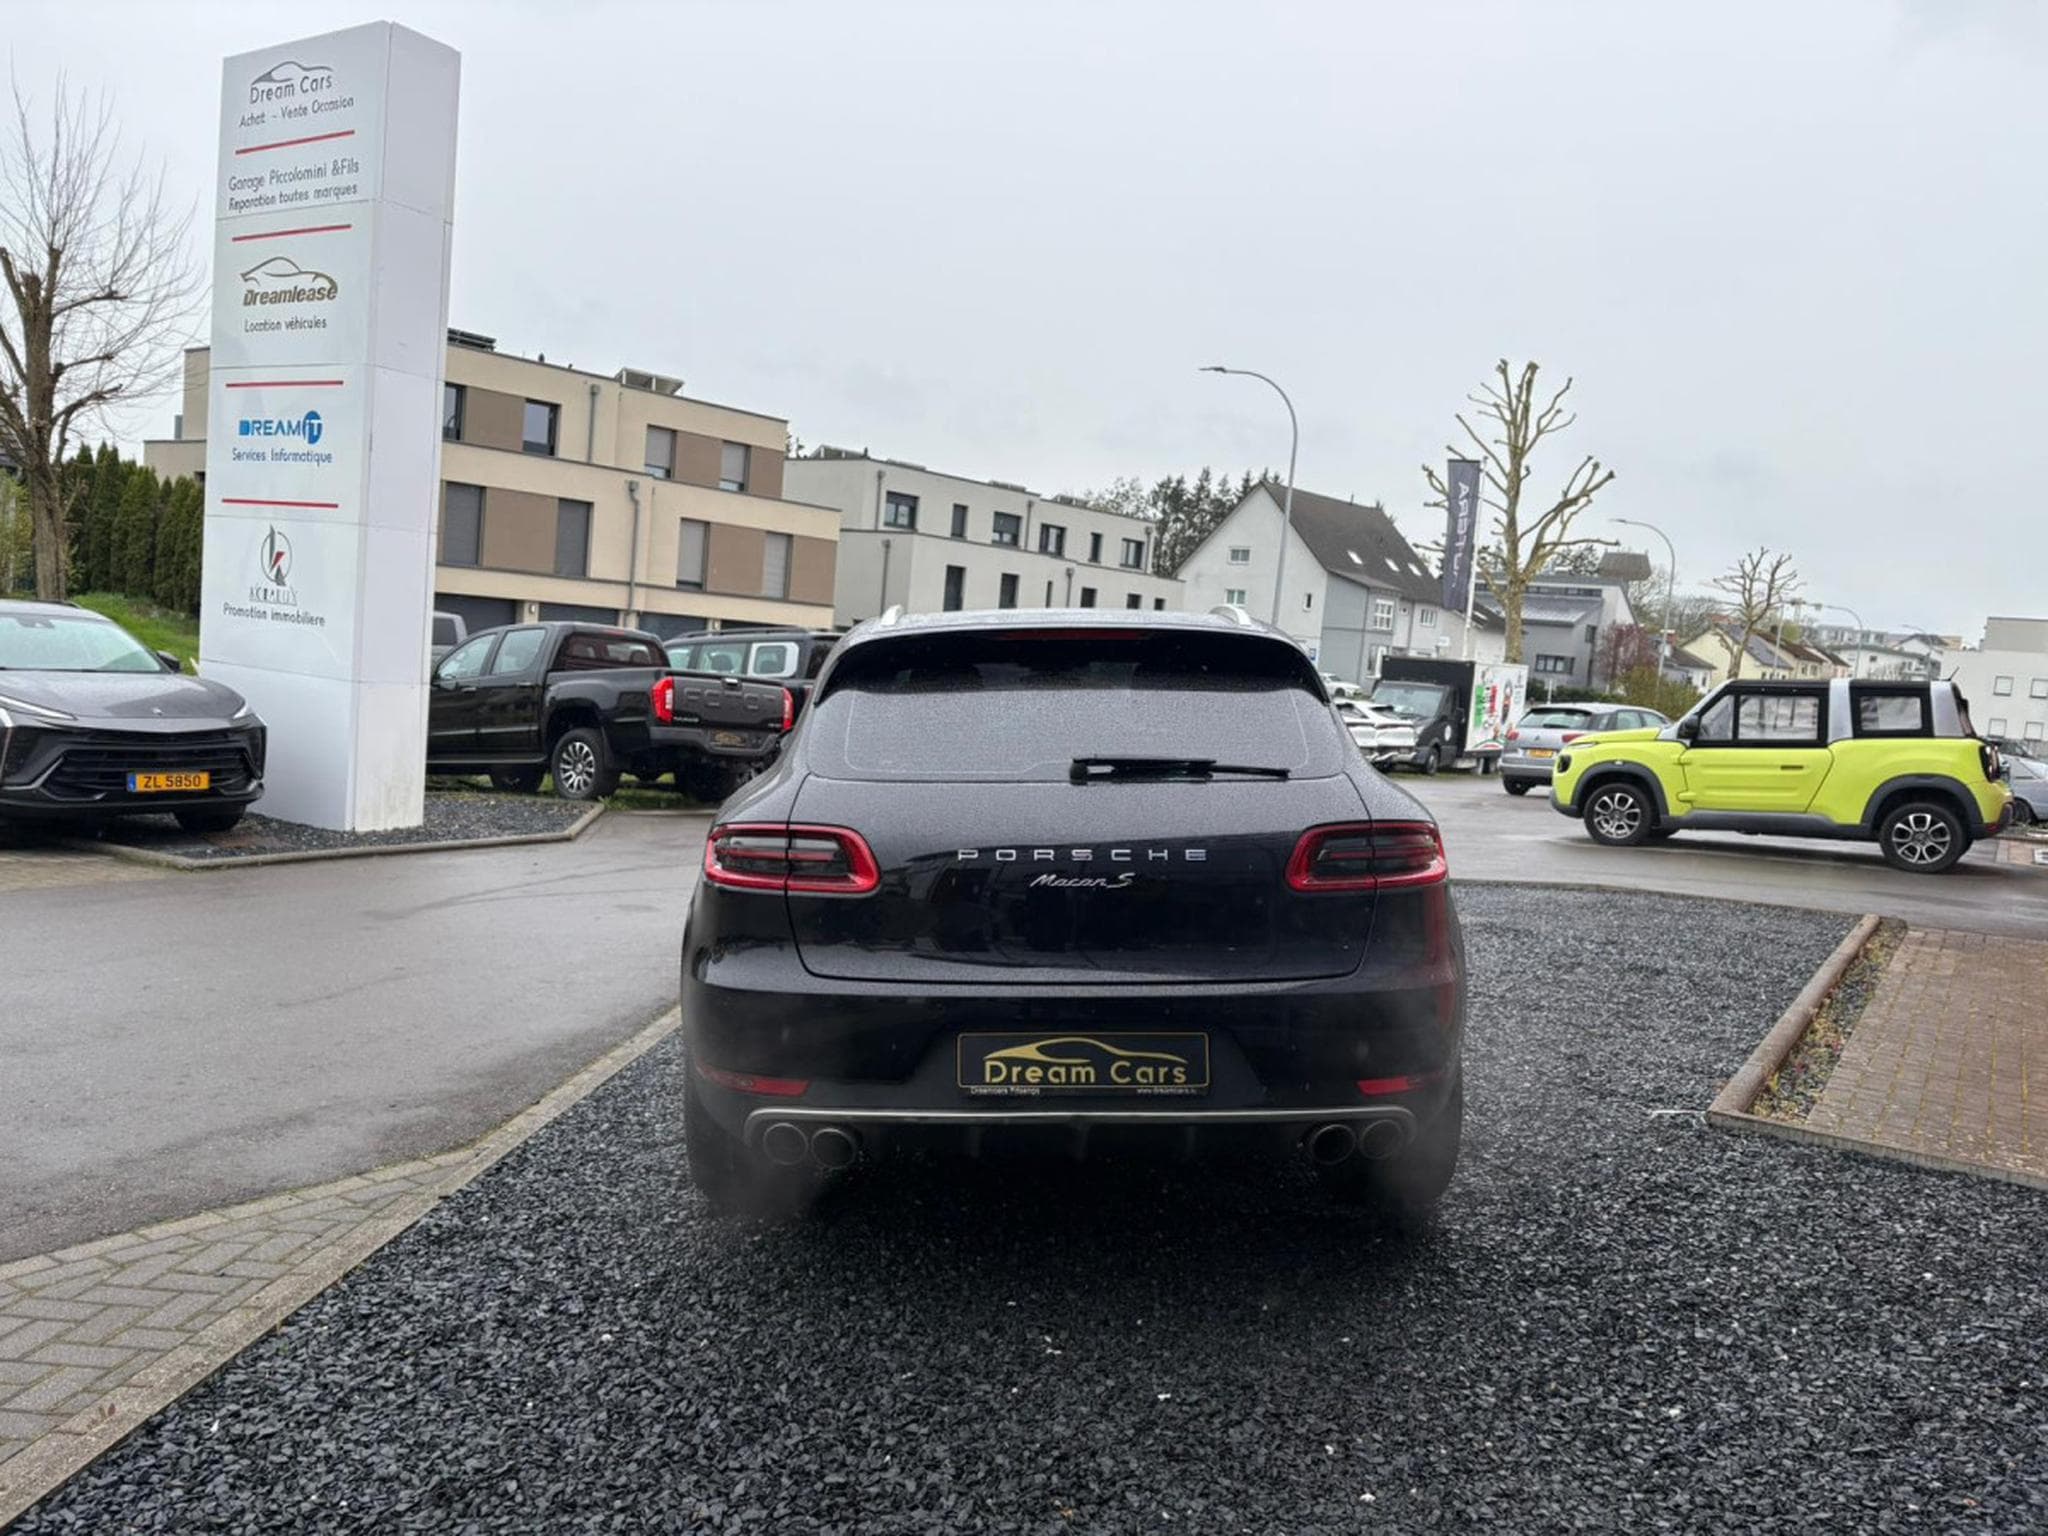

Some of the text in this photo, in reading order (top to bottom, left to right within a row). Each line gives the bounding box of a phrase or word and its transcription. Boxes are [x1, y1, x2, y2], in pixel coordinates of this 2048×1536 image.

[250, 76, 333, 105] Dream Cars
[238, 112, 266, 128] Achat
[281, 104, 308, 119] Vente
[311, 97, 354, 114] Occasion
[228, 175, 265, 193] Garage
[269, 162, 327, 185] Piccolomini
[279, 189, 309, 204] toutes
[313, 183, 358, 200] marques
[243, 285, 338, 306] Dreamlease
[244, 317, 282, 333] Location
[232, 447, 333, 467] Services Informatique
[223, 601, 267, 620] Promotion
[143, 775, 201, 788] ZL 5850
[958, 849, 1207, 861] PORSCHE
[1030, 873, 1107, 888] Macan
[984, 1060, 1187, 1084] Dream Cars
